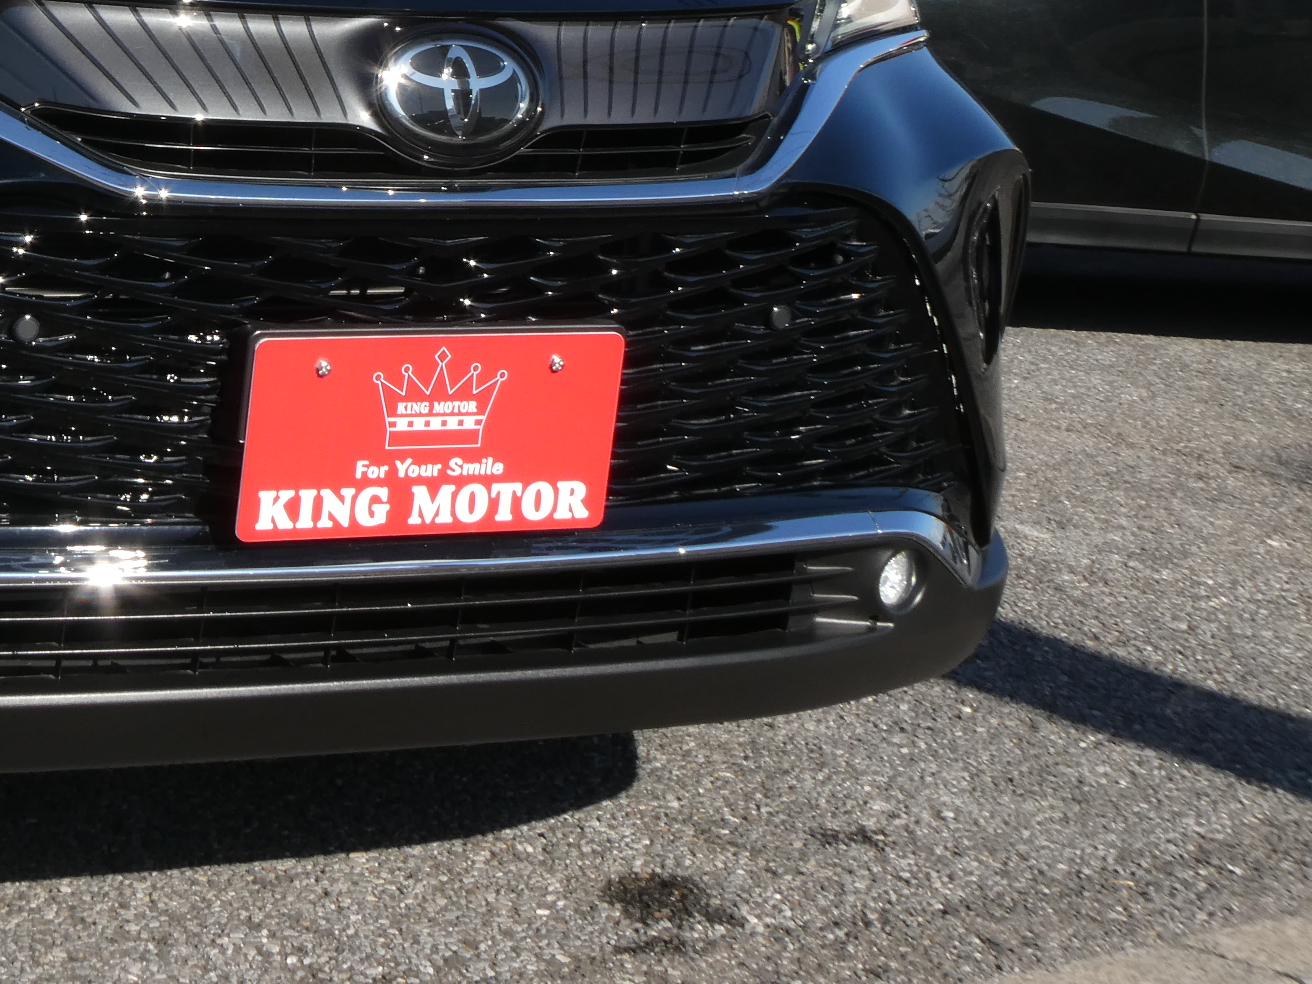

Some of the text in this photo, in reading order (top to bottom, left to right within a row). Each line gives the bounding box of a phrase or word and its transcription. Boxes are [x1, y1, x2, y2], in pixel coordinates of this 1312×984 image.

[396, 400, 478, 414] KING MOTOR
[355, 457, 504, 479] For Your Smile
[255, 480, 589, 530] KING MOTOR
